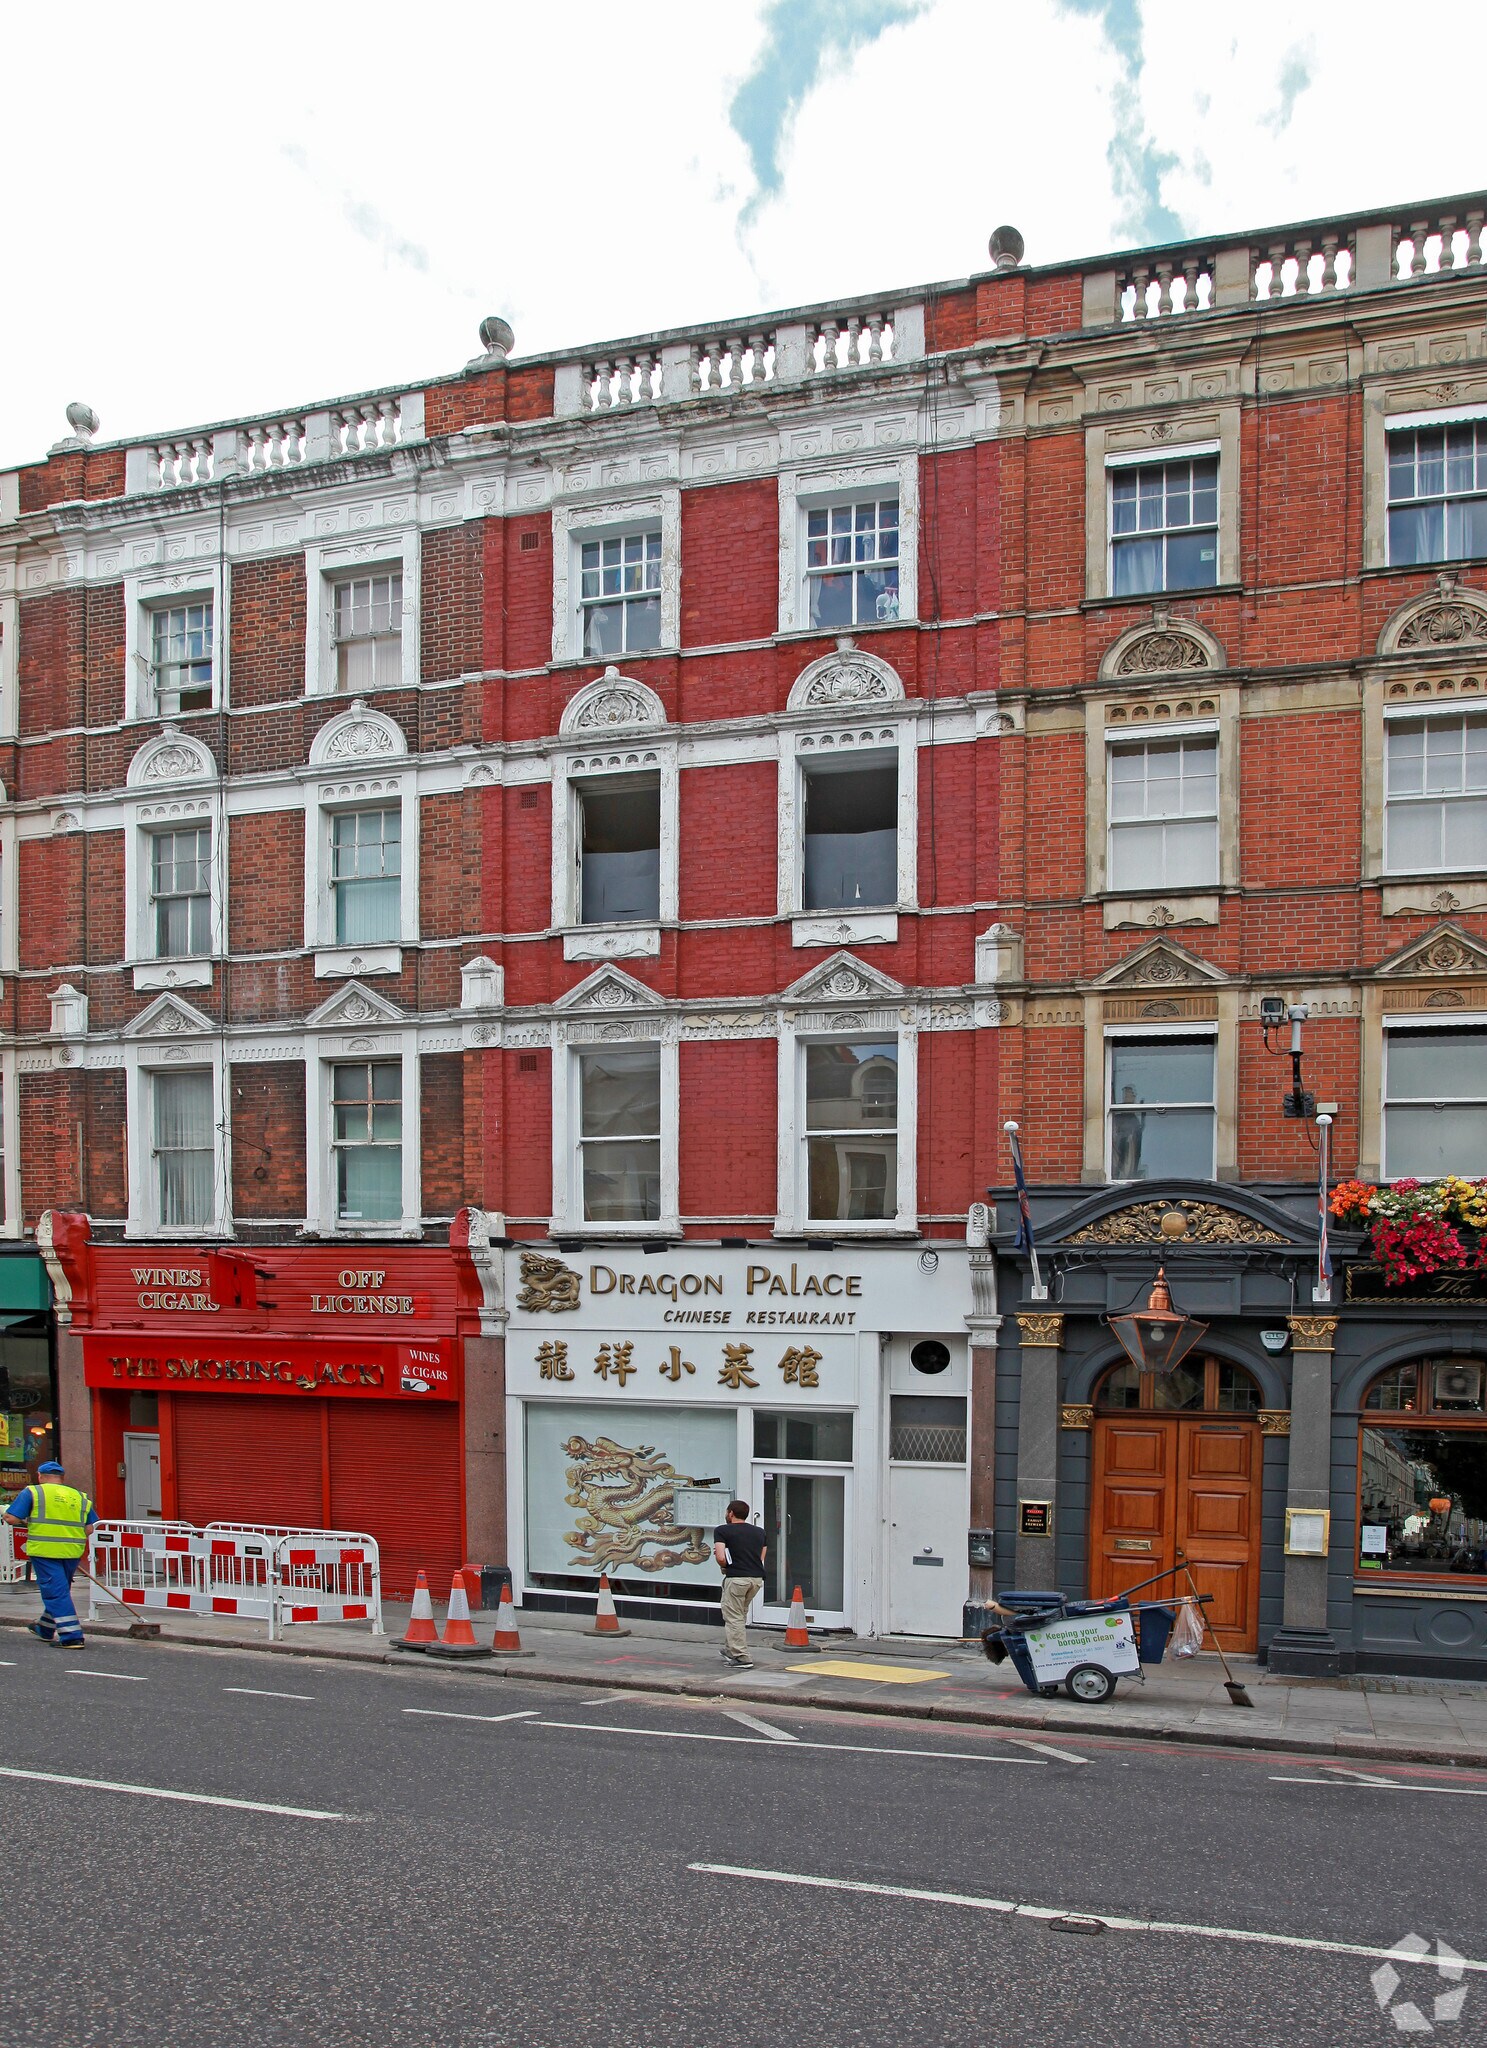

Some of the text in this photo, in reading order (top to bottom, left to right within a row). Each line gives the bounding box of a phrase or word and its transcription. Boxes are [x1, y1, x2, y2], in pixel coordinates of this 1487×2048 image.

[131, 1268, 201, 1287] WINES
[338, 1270, 386, 1288] OFF
[1428, 1275, 1477, 1295] The
[138, 1292, 220, 1311] CIGARS
[310, 1295, 415, 1314] LICENSE
[663, 1309, 856, 1325] CHINESE RESTAURANT
[409, 1349, 441, 1364] WINES
[534, 1340, 823, 1389] 龍祥小菜館
[108, 1357, 161, 1377] THE
[165, 1357, 292, 1382] SMOKING
[402, 1365, 448, 1381] & CIGARS
[1045, 1628, 1098, 1641] Keeping your
[1057, 1633, 1115, 1647] borough clean
